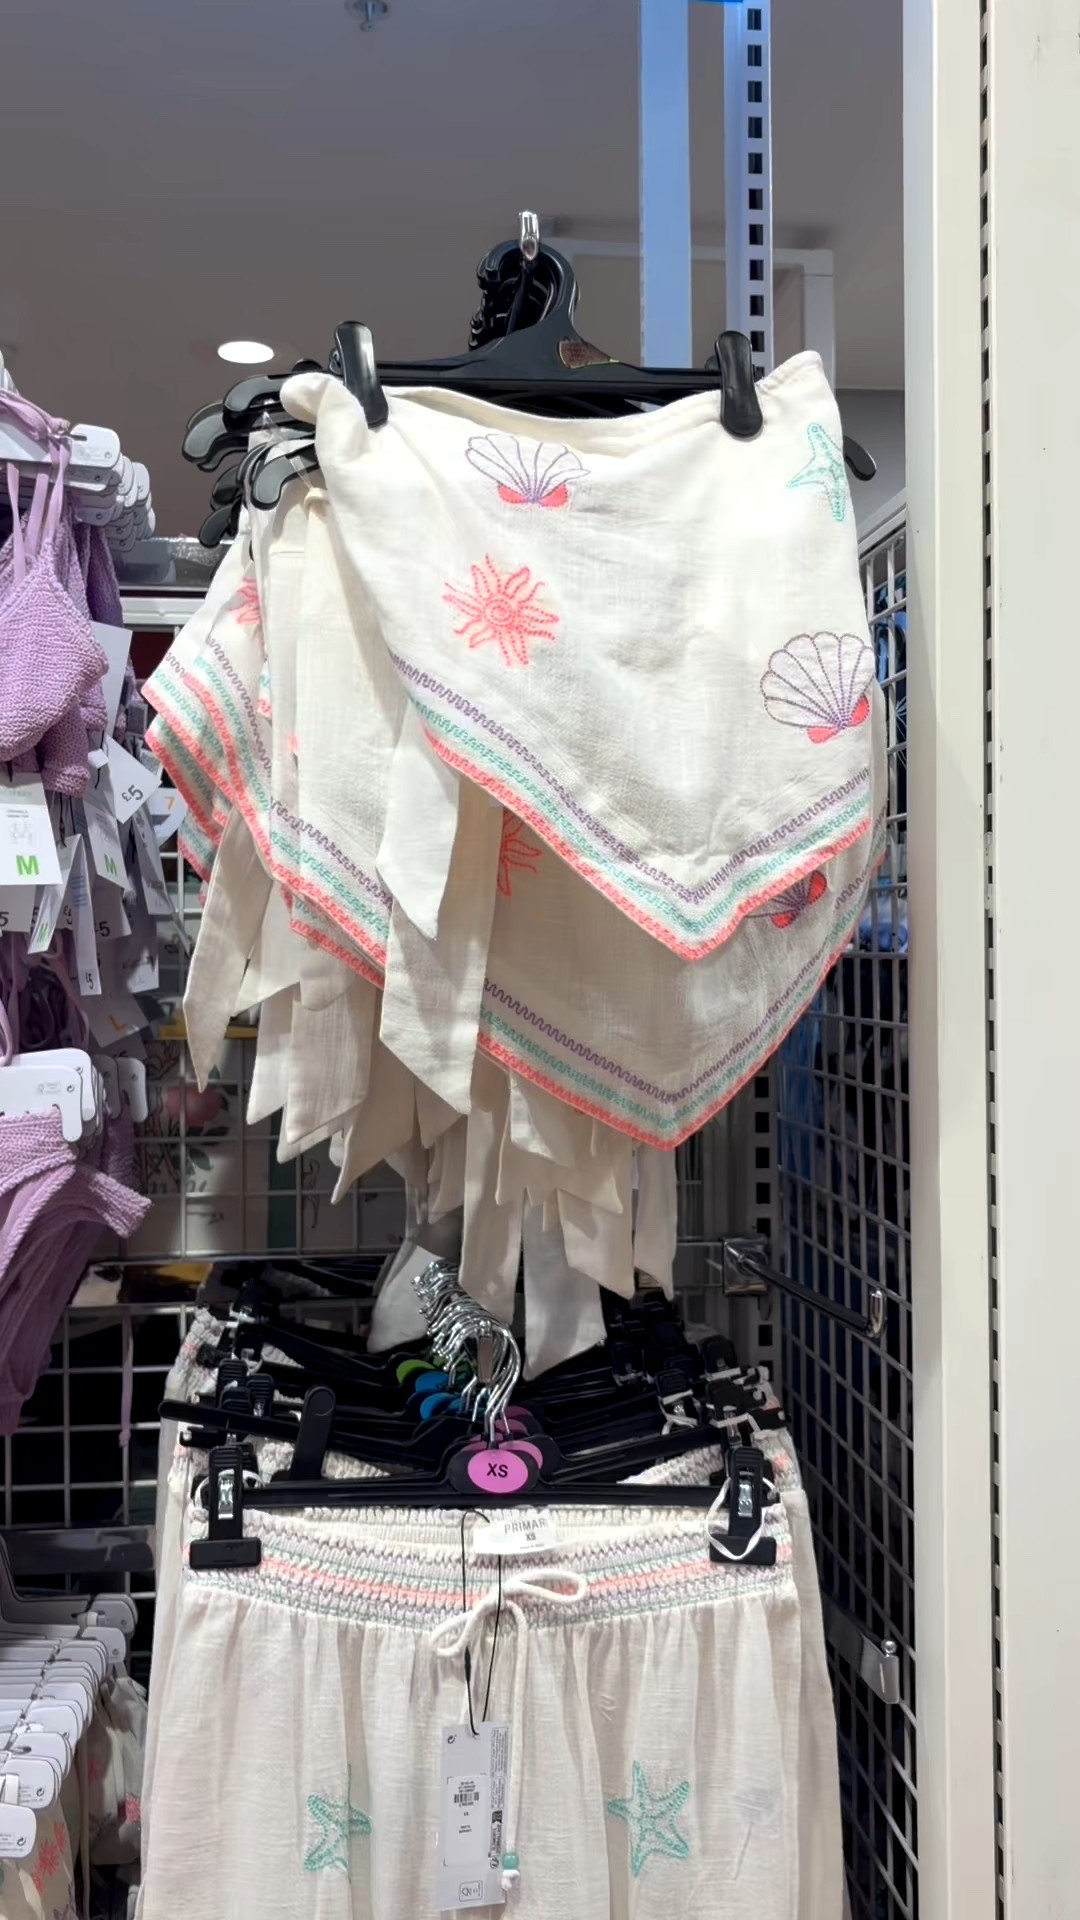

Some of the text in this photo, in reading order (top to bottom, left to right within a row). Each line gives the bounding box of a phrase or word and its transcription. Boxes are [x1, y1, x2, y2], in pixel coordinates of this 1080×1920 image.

[121, 784, 144, 802] £5
[16, 855, 39, 876] M
[104, 854, 118, 877] M
[109, 1014, 126, 1034] L
[486, 1463, 508, 1478] XS
[504, 1518, 546, 1534] PRIMAR
